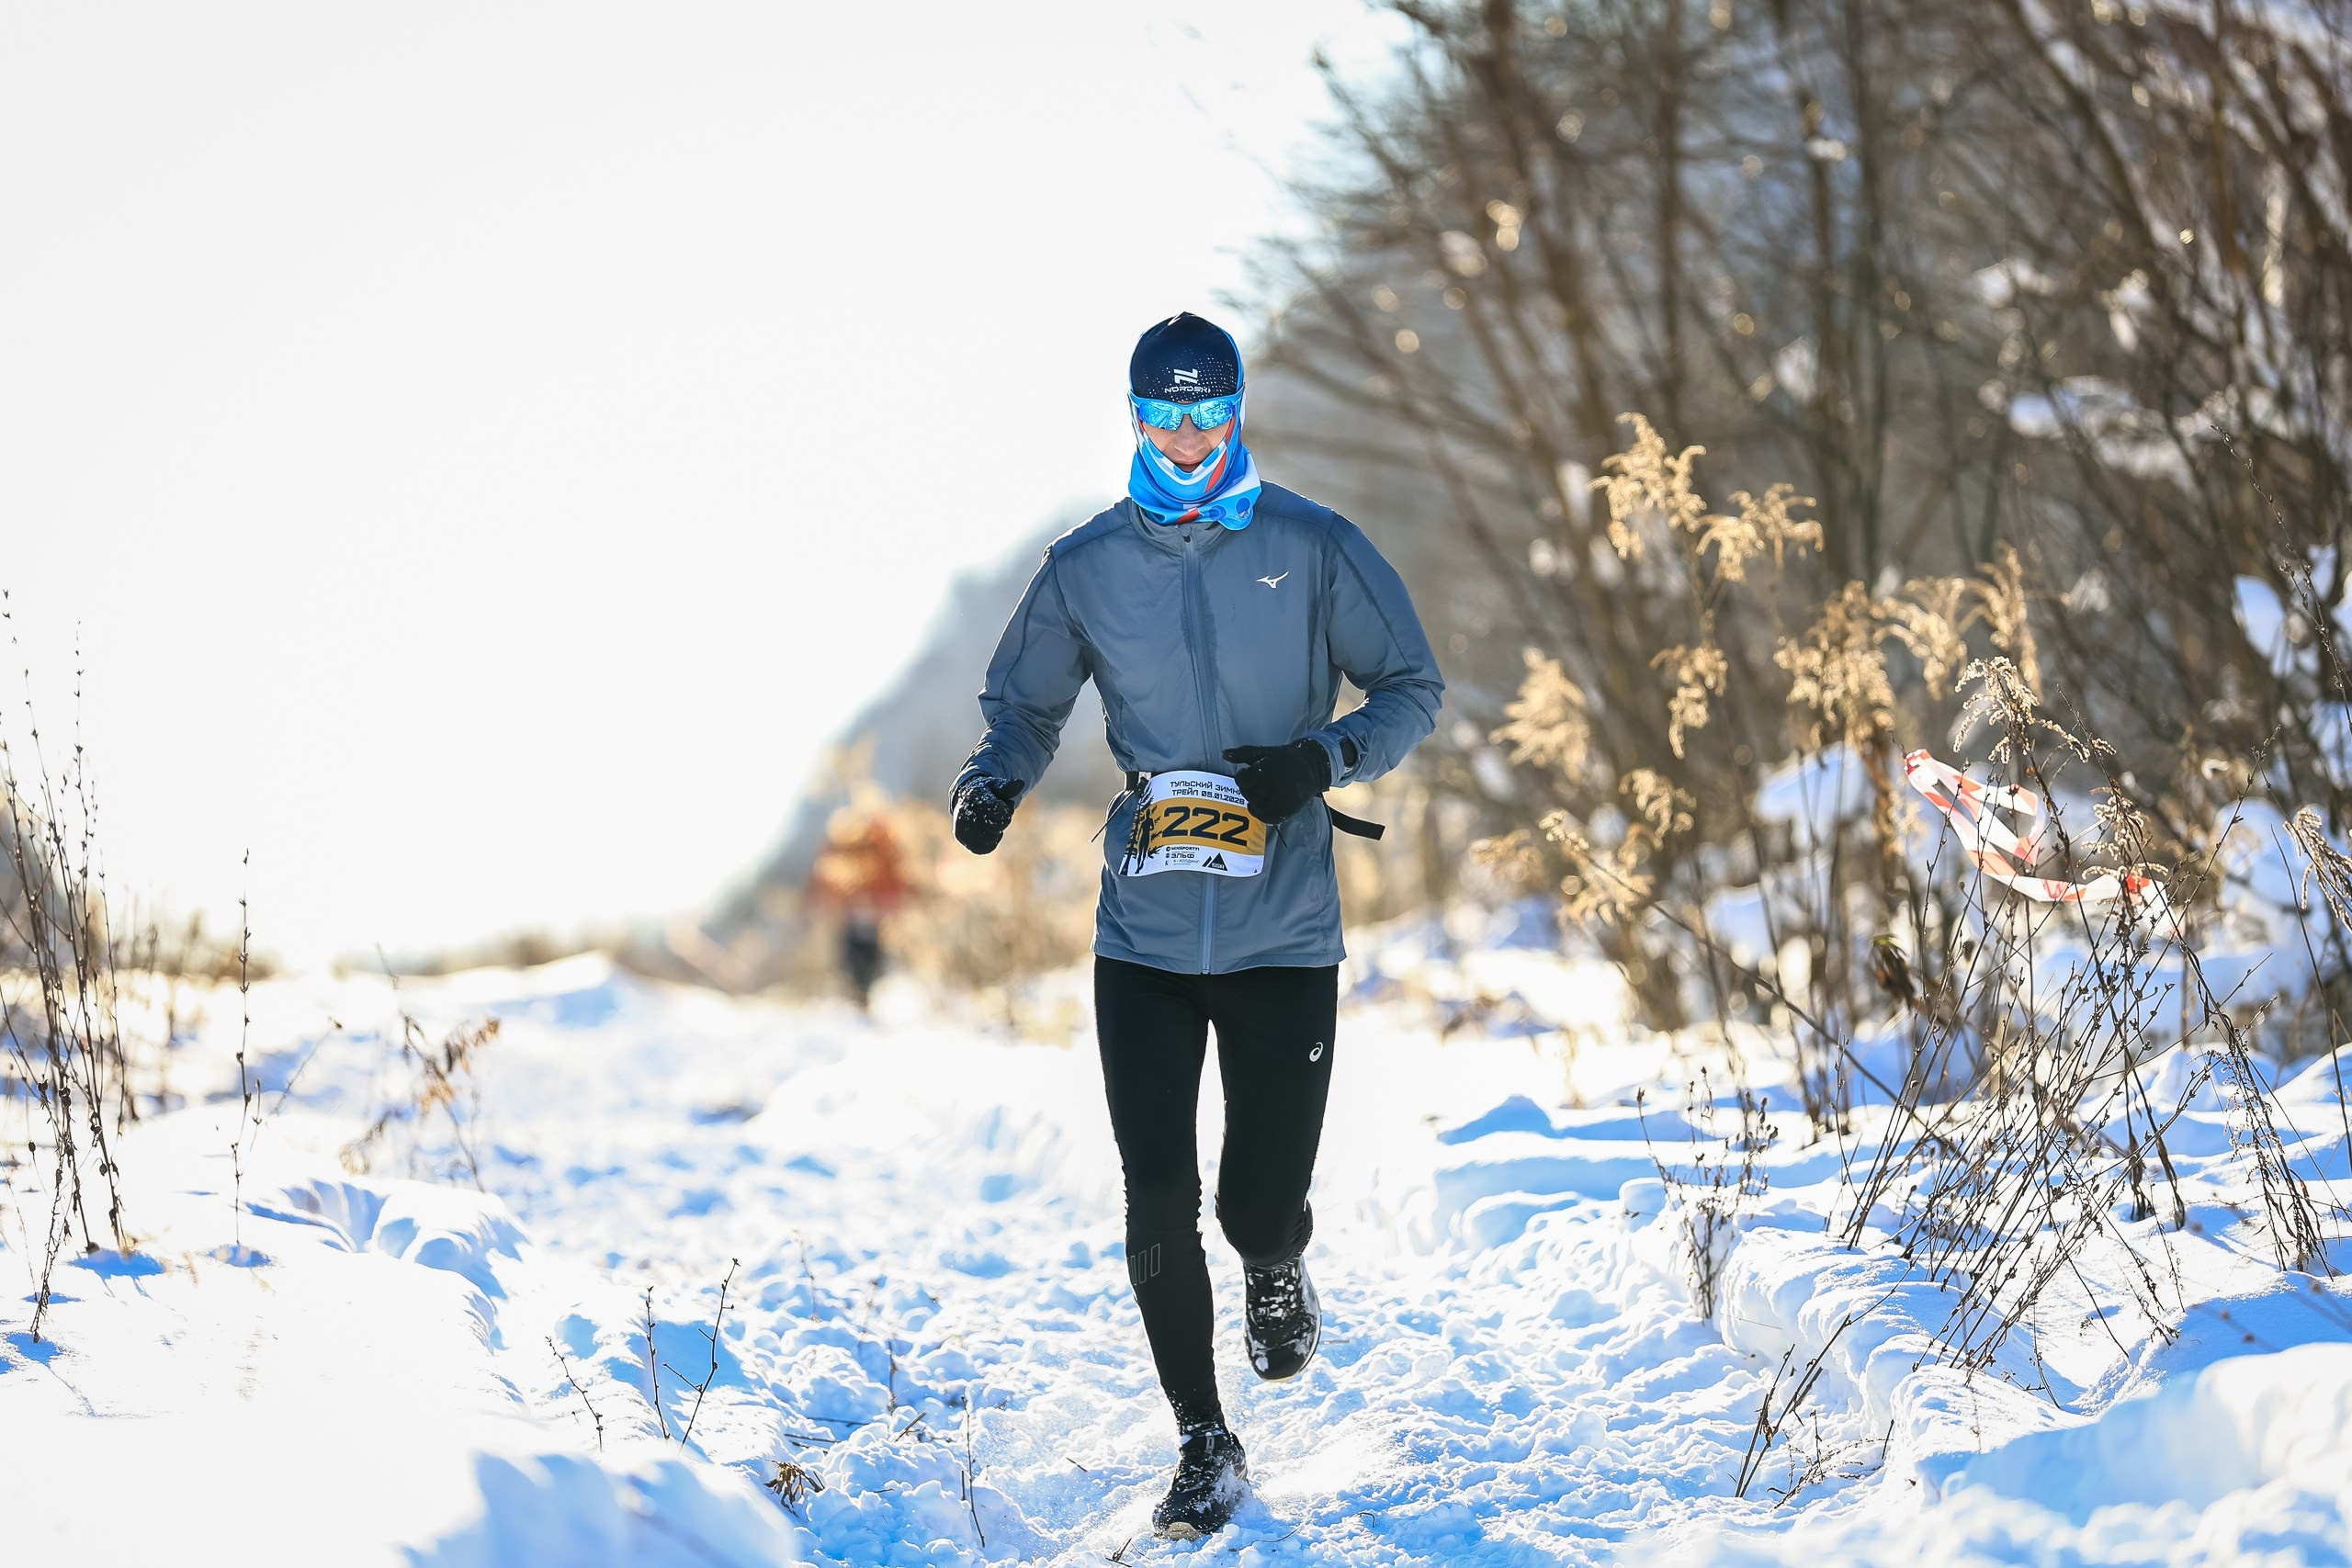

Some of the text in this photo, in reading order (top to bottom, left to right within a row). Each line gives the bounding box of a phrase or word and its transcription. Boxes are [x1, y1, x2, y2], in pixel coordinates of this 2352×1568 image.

[1170, 781, 1241, 795] ТУЛЬСКИЙ ЗИМНИ
[1172, 787, 1198, 795] ТРЕЙЛ
[1162, 806, 1250, 847] 222
